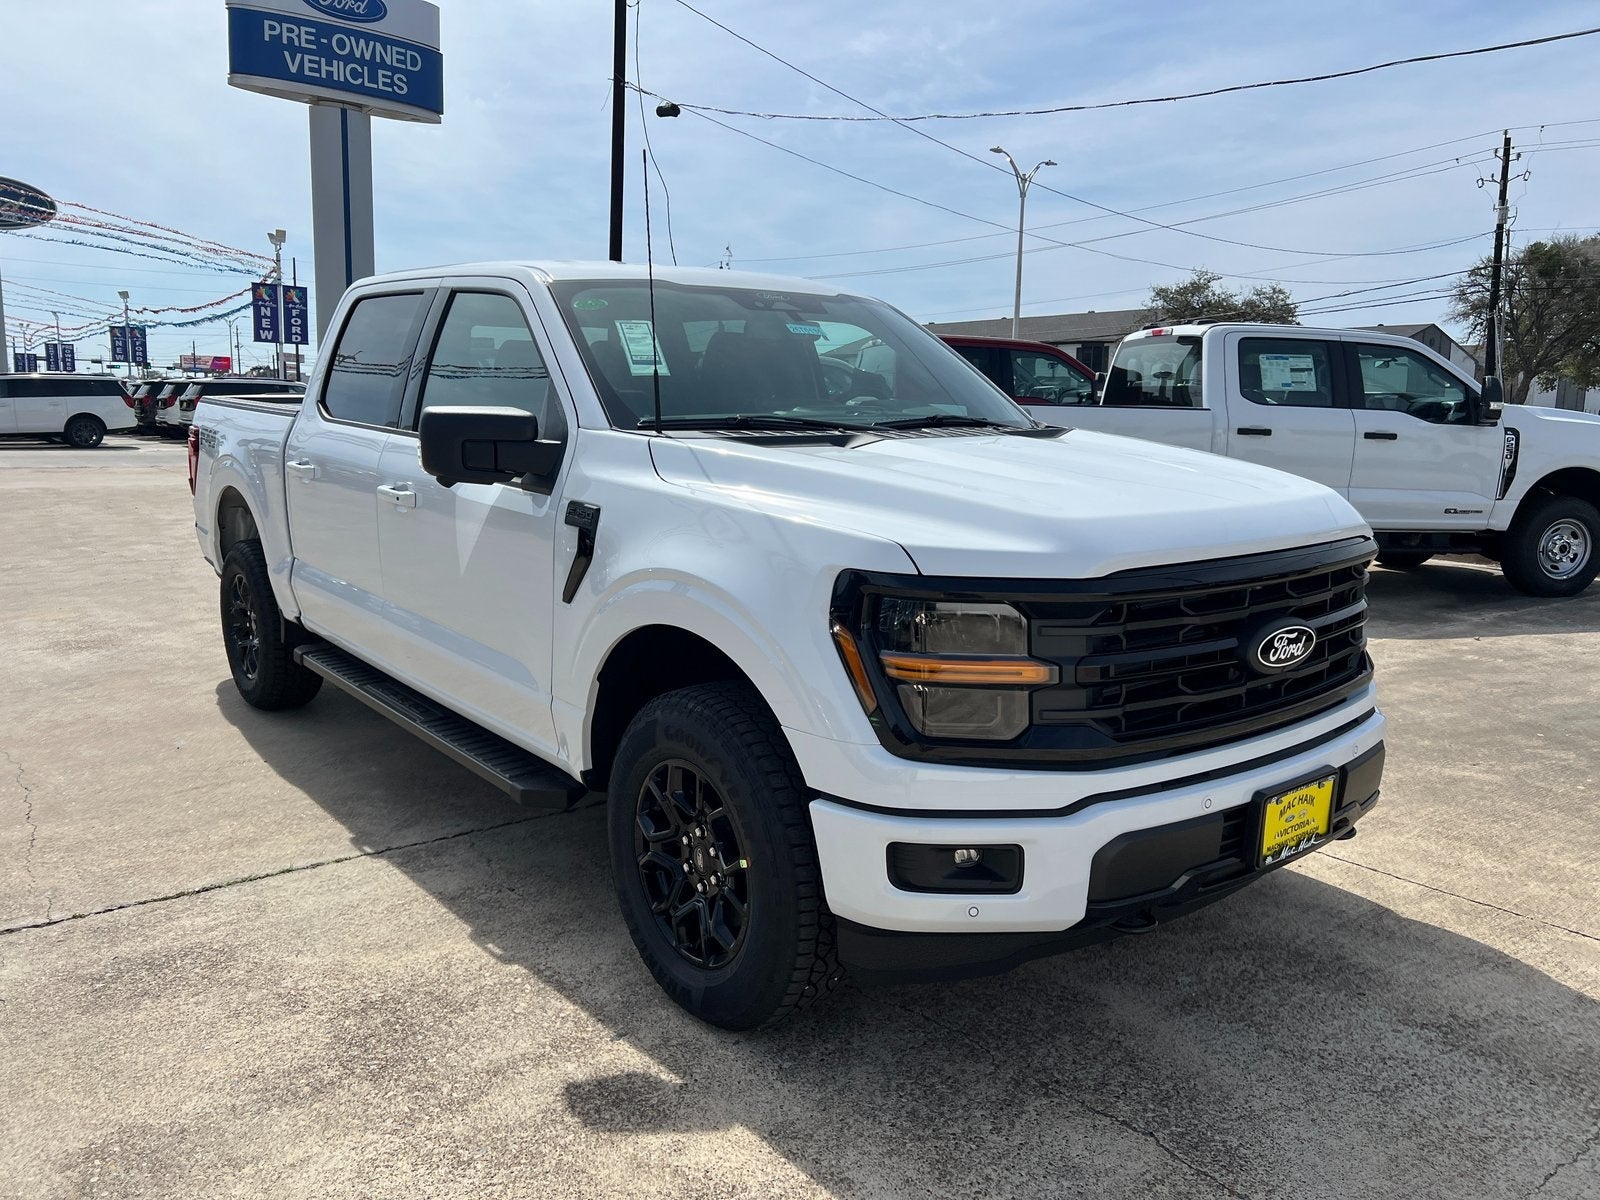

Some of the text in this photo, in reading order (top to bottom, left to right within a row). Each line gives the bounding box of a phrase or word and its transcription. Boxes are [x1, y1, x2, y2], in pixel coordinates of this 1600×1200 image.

[283, 50, 409, 95] VEHICLES
[260, 306, 273, 340] NEW
[290, 309, 302, 342] FORD
[115, 340, 124, 361] NEW
[1269, 631, 1307, 662] Ford
[1279, 793, 1316, 820] MAC HAIK
